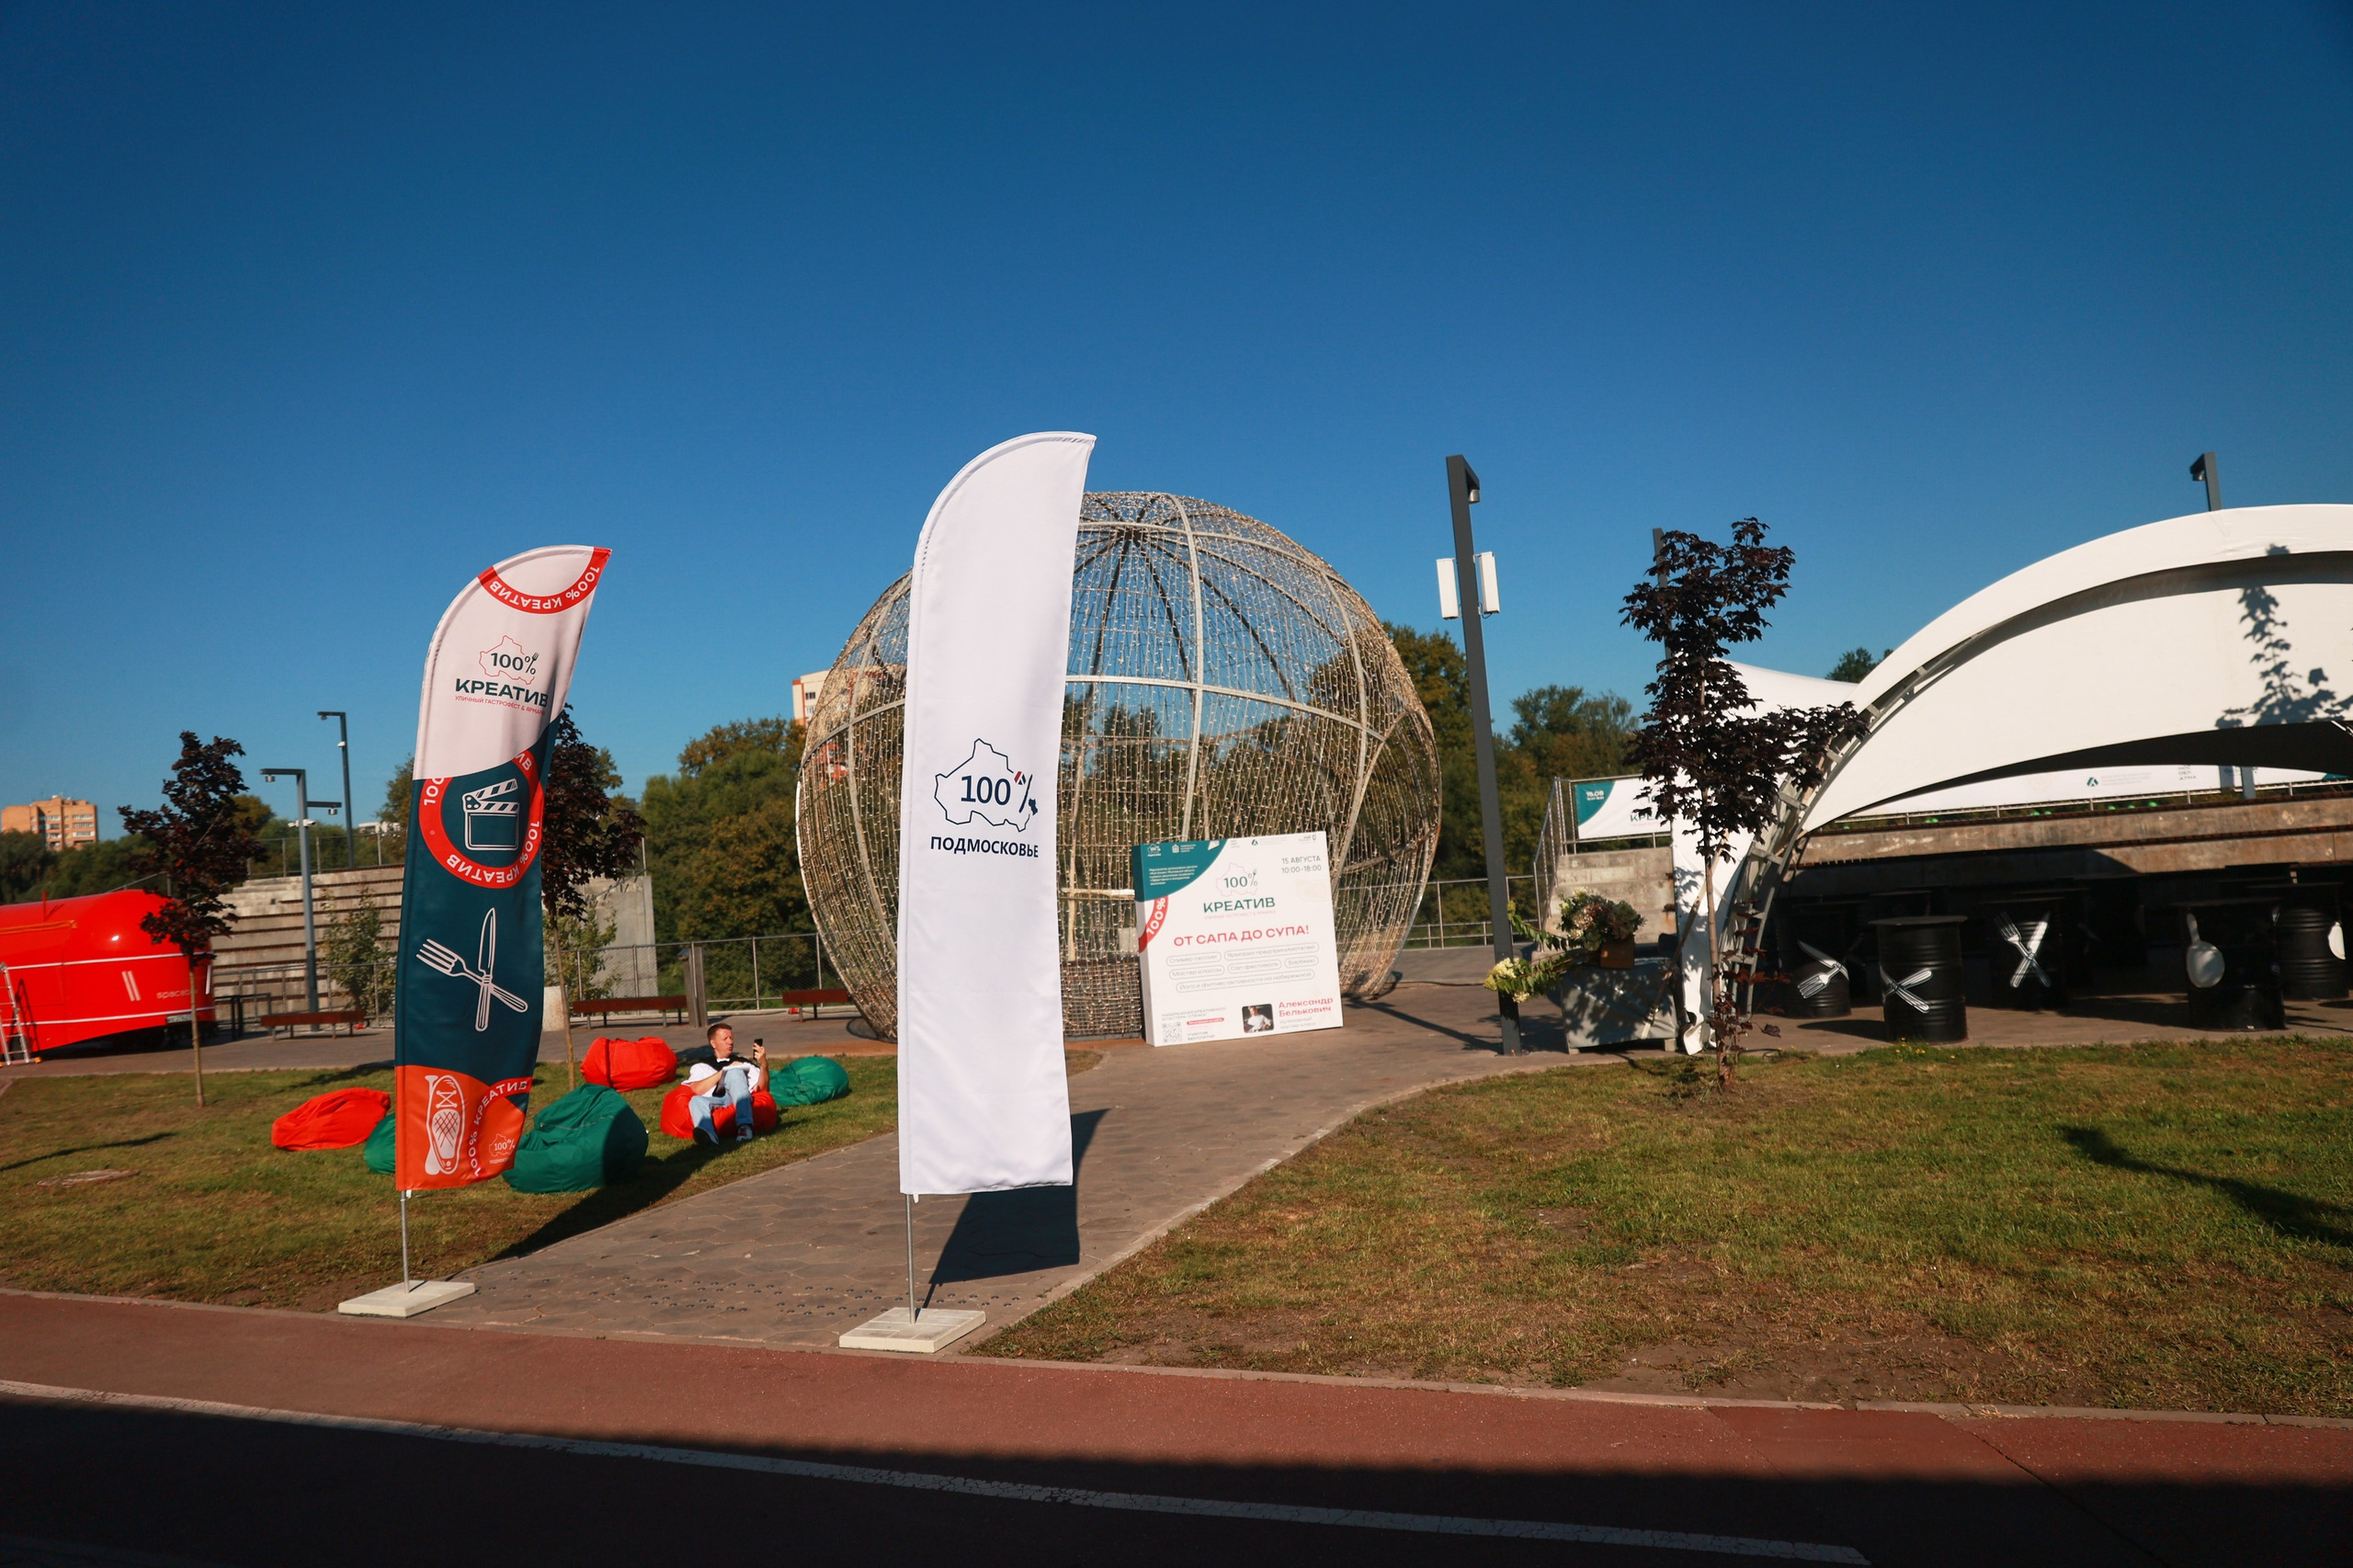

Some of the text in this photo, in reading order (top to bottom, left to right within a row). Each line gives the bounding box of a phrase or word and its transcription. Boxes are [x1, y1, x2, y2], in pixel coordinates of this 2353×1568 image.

[489, 566, 600, 610] 100% КРЕАТИВ
[490, 652, 540, 676] 100%
[455, 678, 549, 708] КРЕАТИВ
[455, 695, 484, 704] УЛИЧНЫЙ
[484, 699, 520, 710] ГАСТРОФЕСТ
[961, 771, 1039, 816] 100%
[446, 821, 540, 884] 100% КРЕАТИВ
[930, 836, 1039, 858] ПОДМОСКОВЬЕ
[1281, 864, 1322, 874] 10:00-18:00
[1290, 855, 1321, 864] АВГУСТА
[1223, 869, 1258, 889] 100%
[1146, 897, 1165, 935] 100%
[1203, 897, 1276, 914] КРЕАТИВ
[1173, 925, 1310, 947] ОТ САПА ДО СУПА!
[1279, 997, 1334, 1008] Александр
[1279, 1006, 1332, 1017] Белькович
[468, 1081, 528, 1176] 100% КРЕАТИВ
